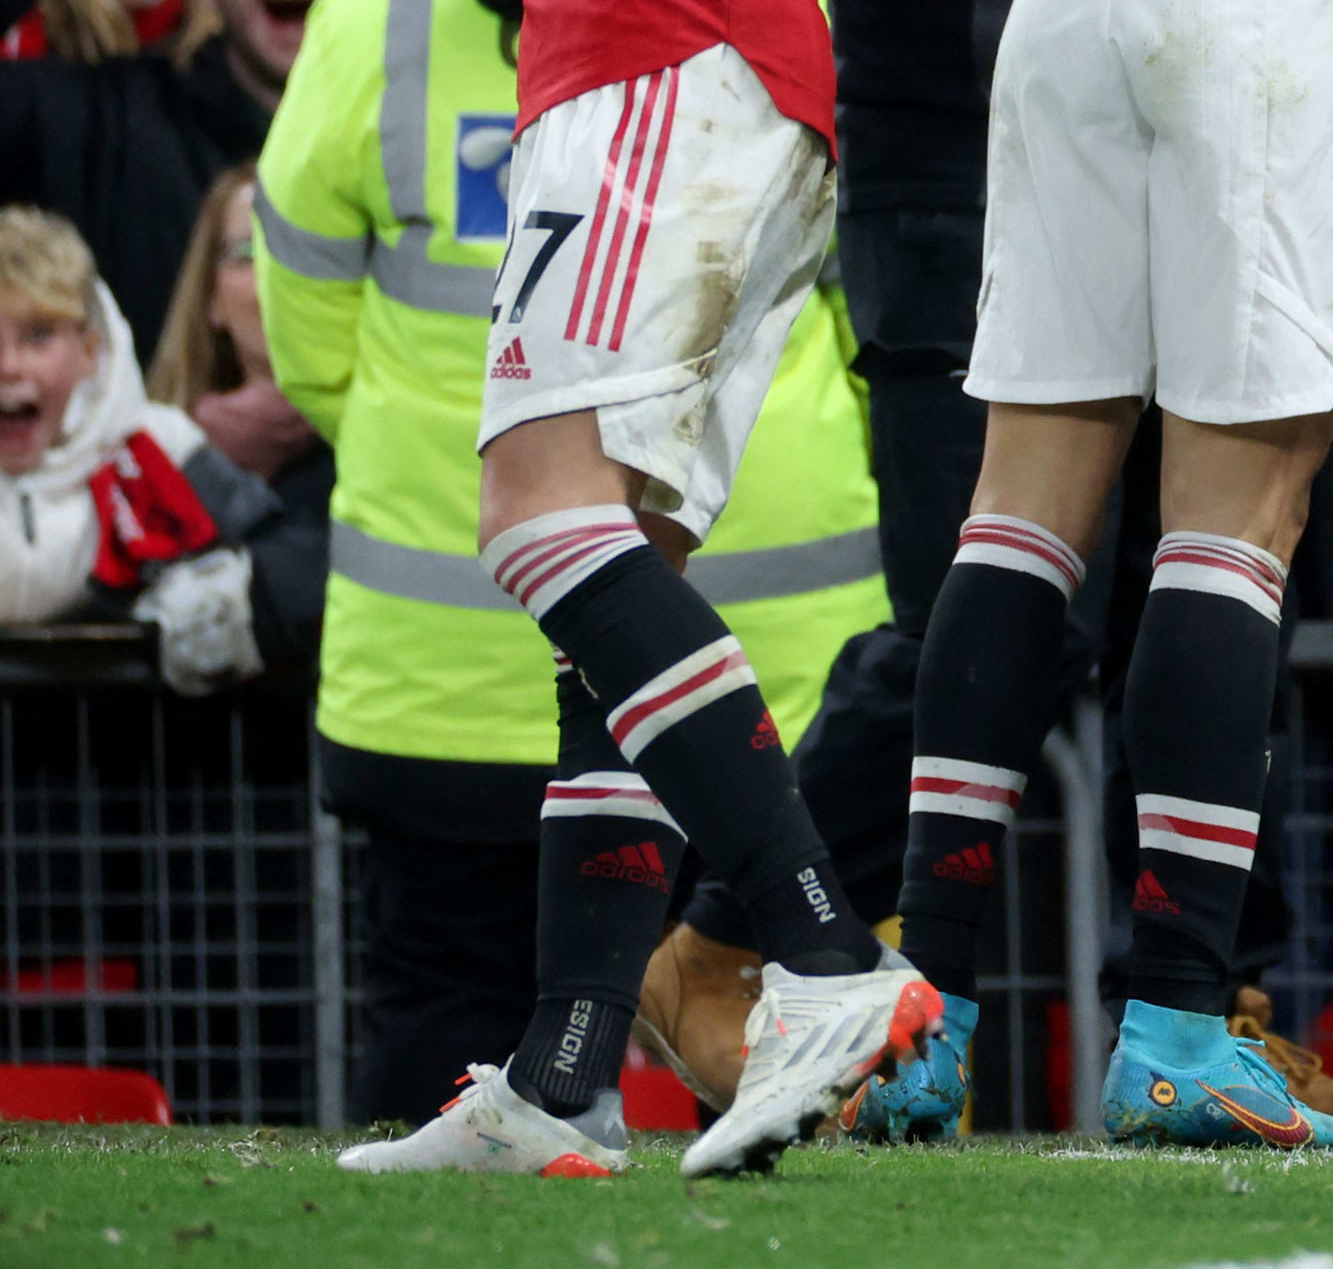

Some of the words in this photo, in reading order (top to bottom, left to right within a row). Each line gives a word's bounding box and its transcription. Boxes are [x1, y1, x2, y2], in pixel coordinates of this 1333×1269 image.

[580, 859, 670, 894] adidas
[797, 867, 837, 924] SIGN
[554, 999, 593, 1075] ESIGN
